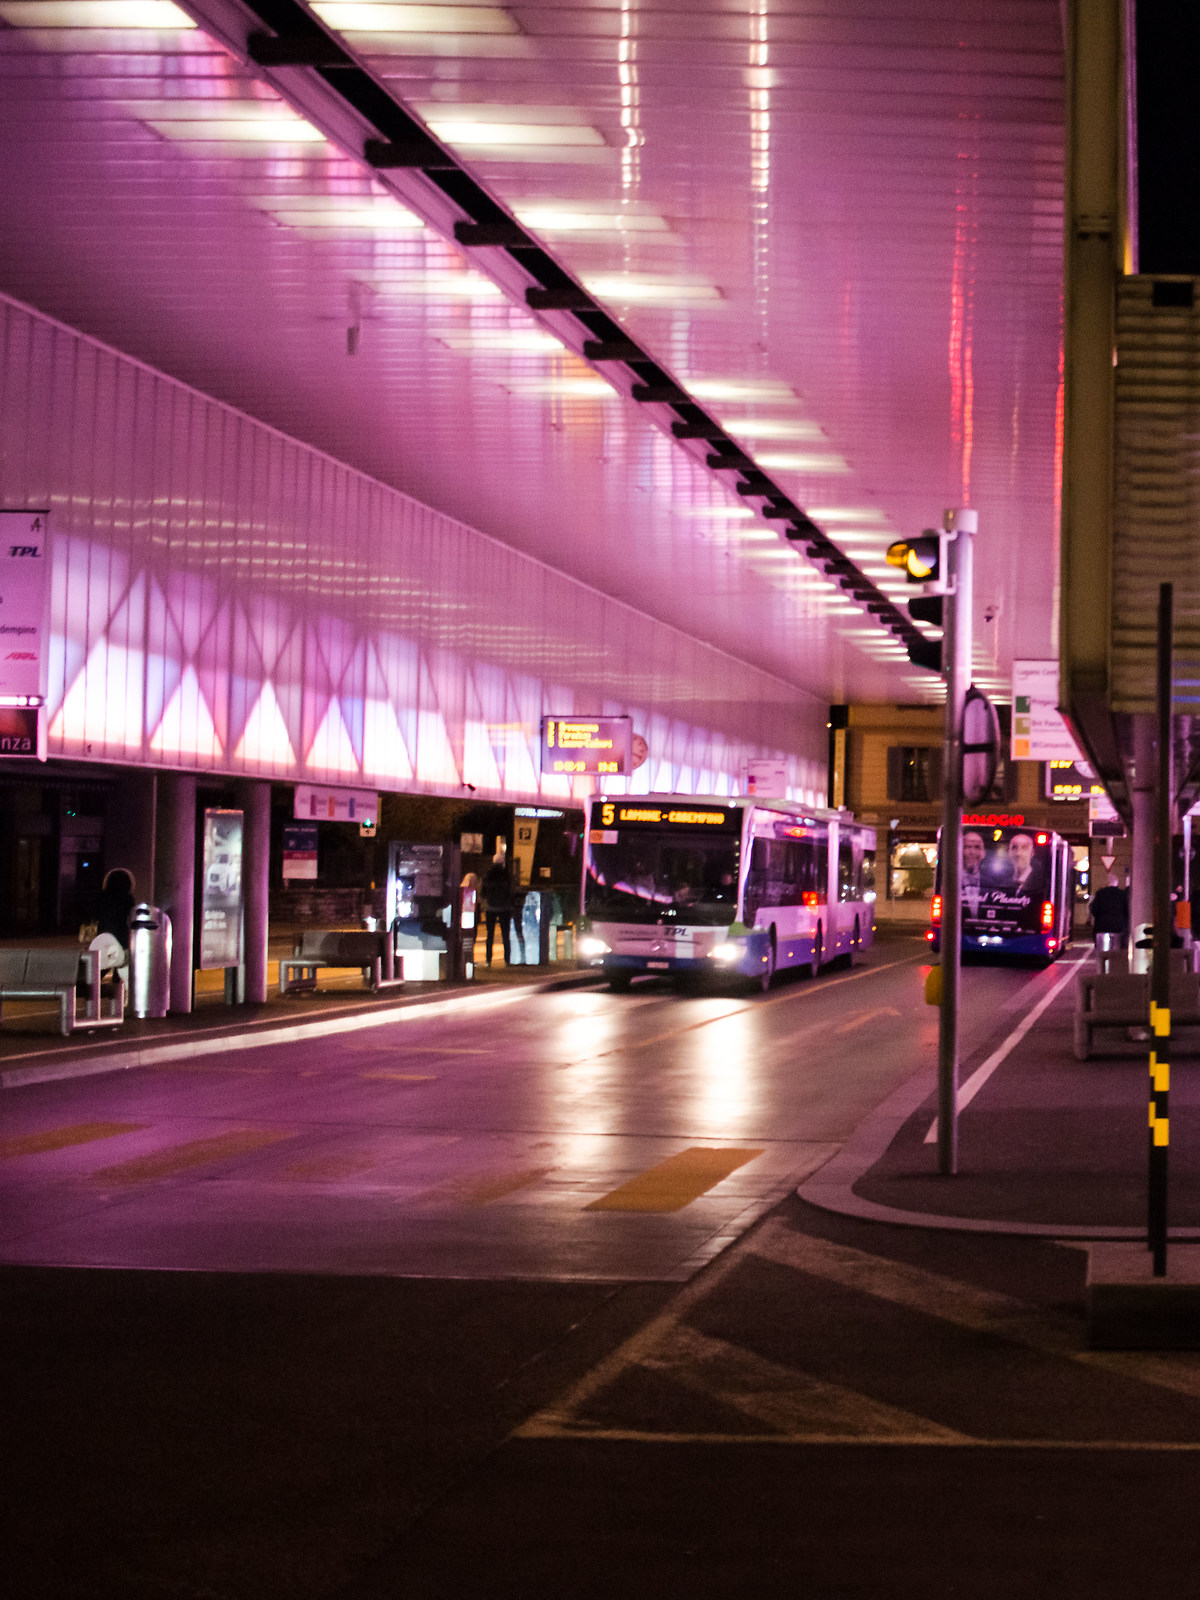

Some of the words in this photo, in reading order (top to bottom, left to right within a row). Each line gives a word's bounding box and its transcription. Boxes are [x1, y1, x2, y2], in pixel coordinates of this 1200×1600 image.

[9, 546, 41, 557] TPL
[1, 737, 32, 750] nza
[602, 803, 615, 826] 5
[993, 829, 1003, 841] 7
[664, 926, 689, 936] TPL
